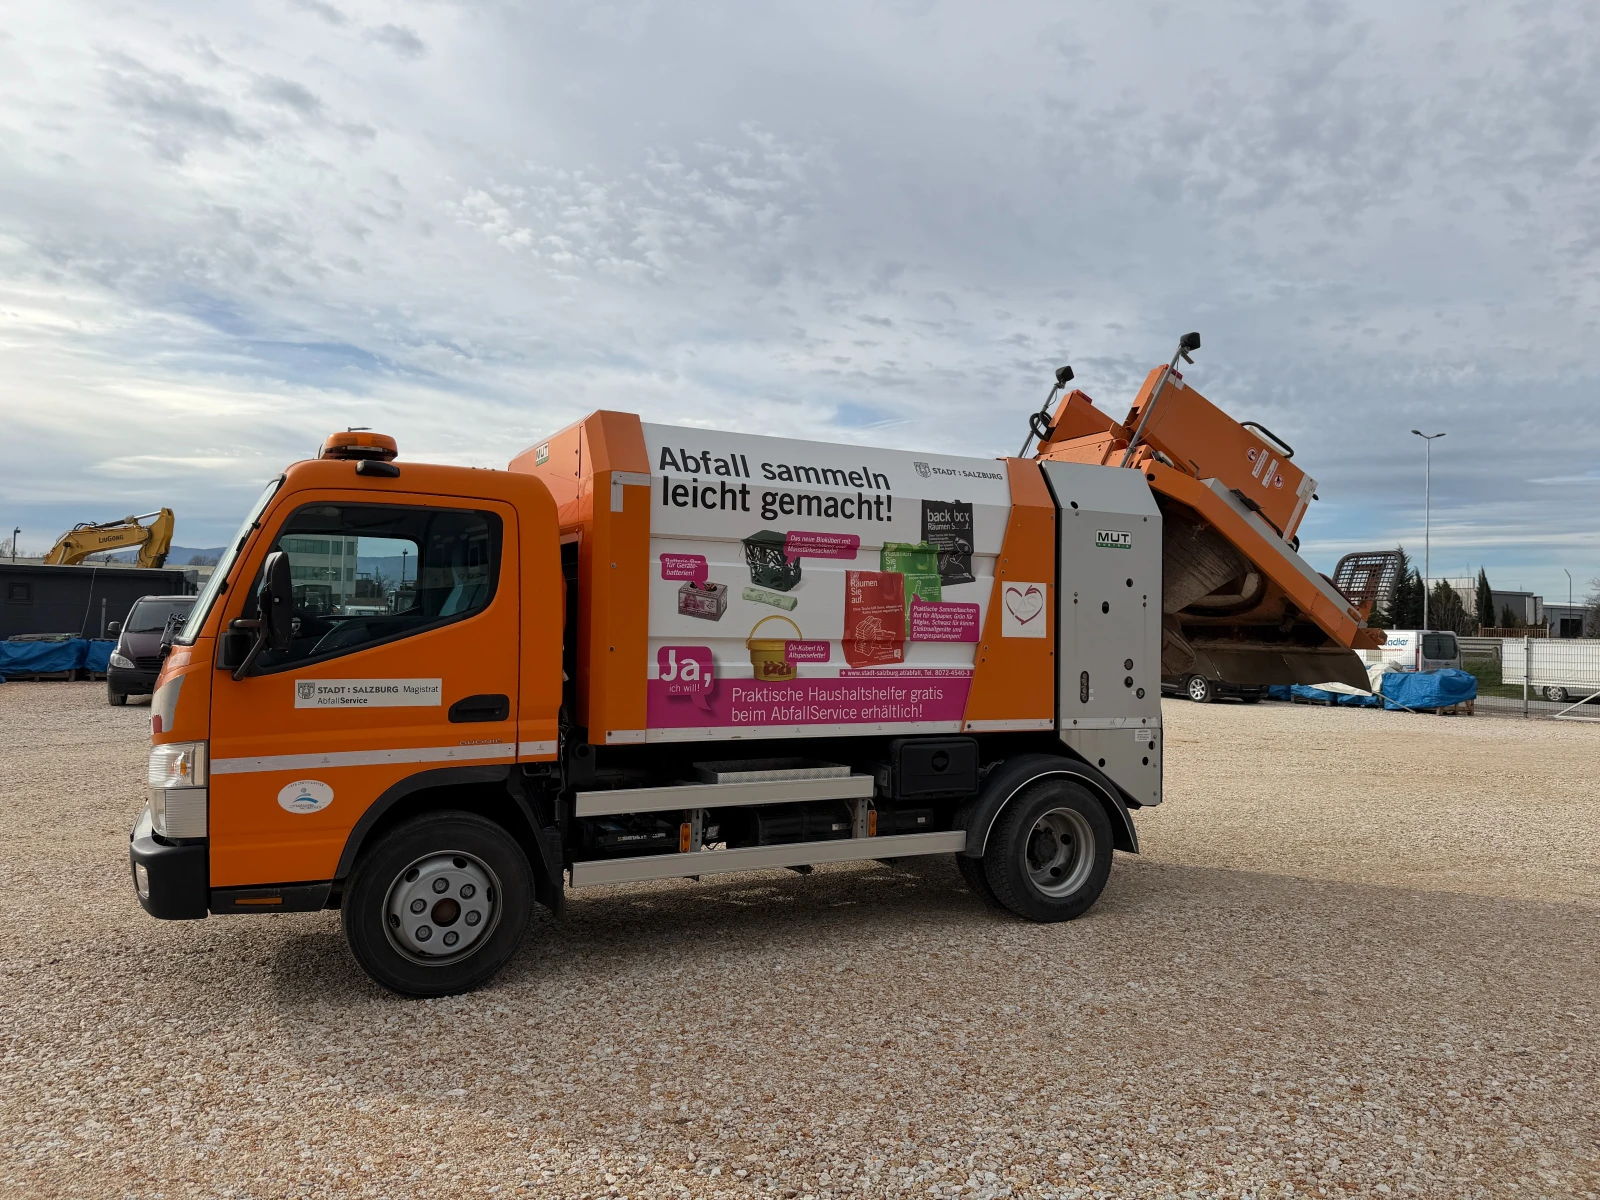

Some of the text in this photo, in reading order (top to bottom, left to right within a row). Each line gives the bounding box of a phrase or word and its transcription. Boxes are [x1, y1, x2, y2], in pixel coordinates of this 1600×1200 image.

[659, 446, 891, 490] Abfall sammeln
[932, 467, 957, 476] STADT
[963, 471, 1003, 480] SALZBURG
[662, 475, 892, 522] leicht gemacht!
[927, 508, 951, 522] back
[790, 534, 801, 542] Das
[1097, 531, 1130, 543] MUT
[850, 578, 878, 587] Räumen
[850, 587, 862, 596] Sie
[851, 595, 865, 603] auf.
[1384, 637, 1409, 646] adler
[816, 644, 825, 652] für
[660, 649, 712, 688] Ja,
[317, 686, 346, 694] STADT
[352, 686, 399, 694] SALZBURG
[403, 685, 439, 695] Magistrat
[669, 683, 700, 693] ich will!
[732, 685, 944, 703] Praktische Haushaltshelfer gratis
[317, 697, 368, 705] AbfallService
[731, 703, 923, 722] beim AbfallService erhältlich!
